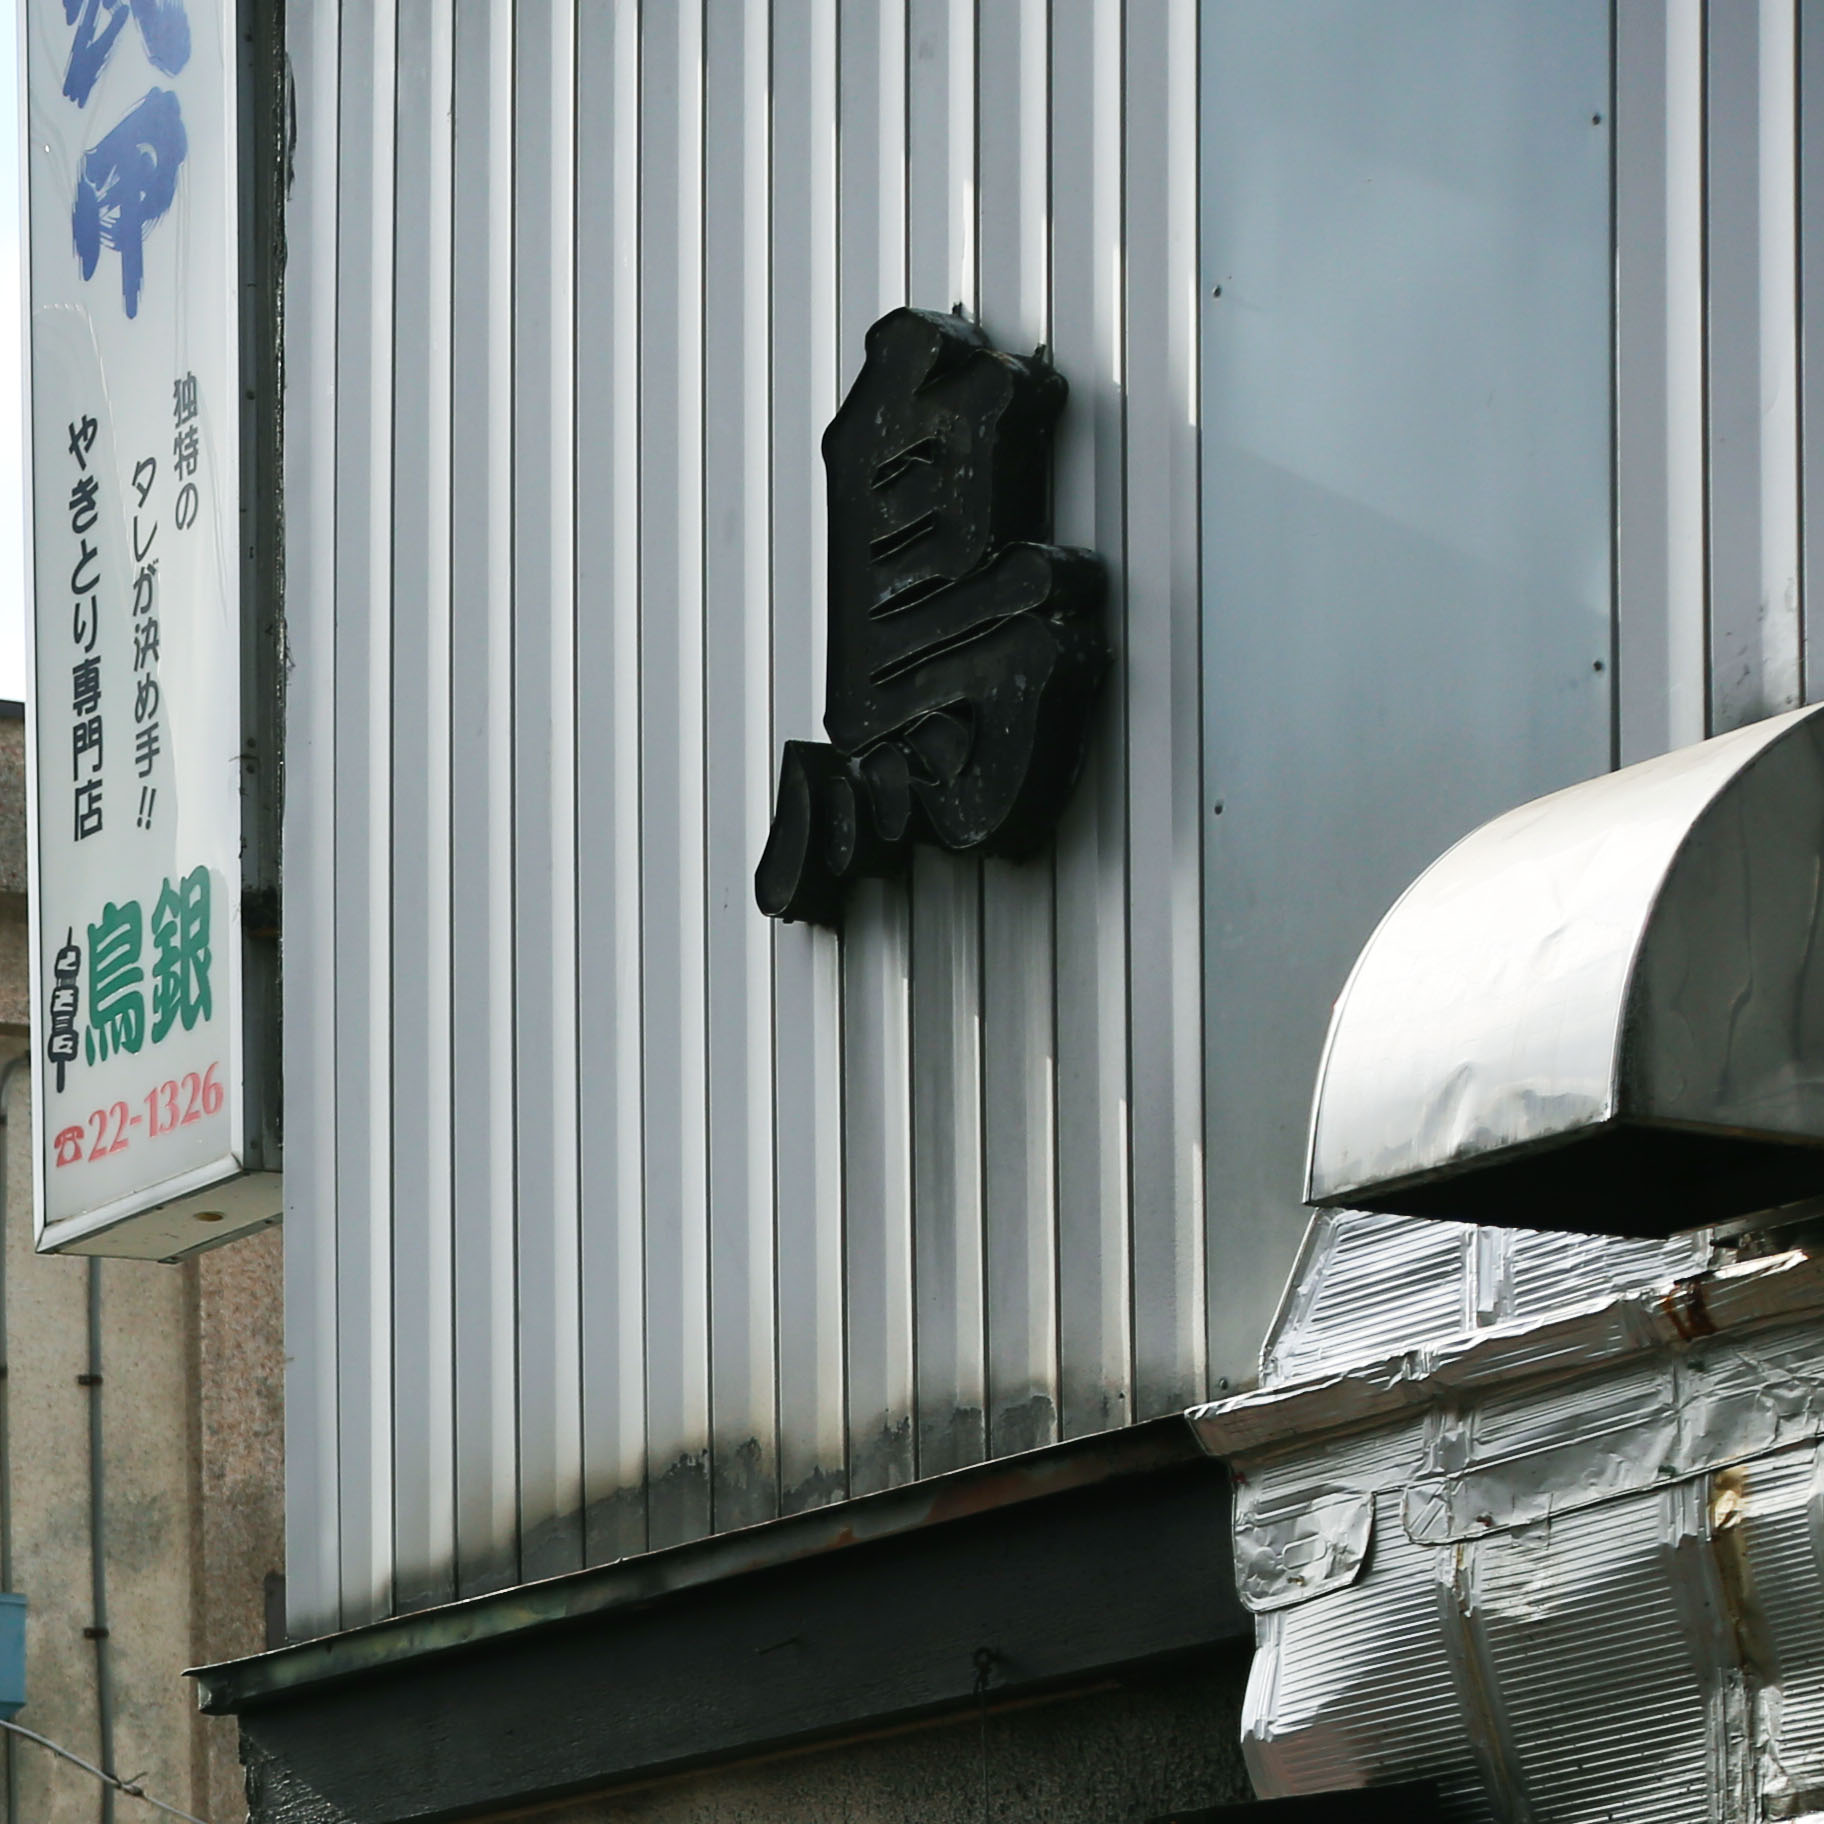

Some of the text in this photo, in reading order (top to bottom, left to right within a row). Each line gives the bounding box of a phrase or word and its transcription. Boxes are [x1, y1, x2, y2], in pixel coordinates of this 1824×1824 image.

[173, 371, 200, 531] 独特の
[68, 413, 104, 842] やきとり専門店
[85, 865, 213, 1067] 鳥銀
[87, 1061, 225, 1163] 22-1326
